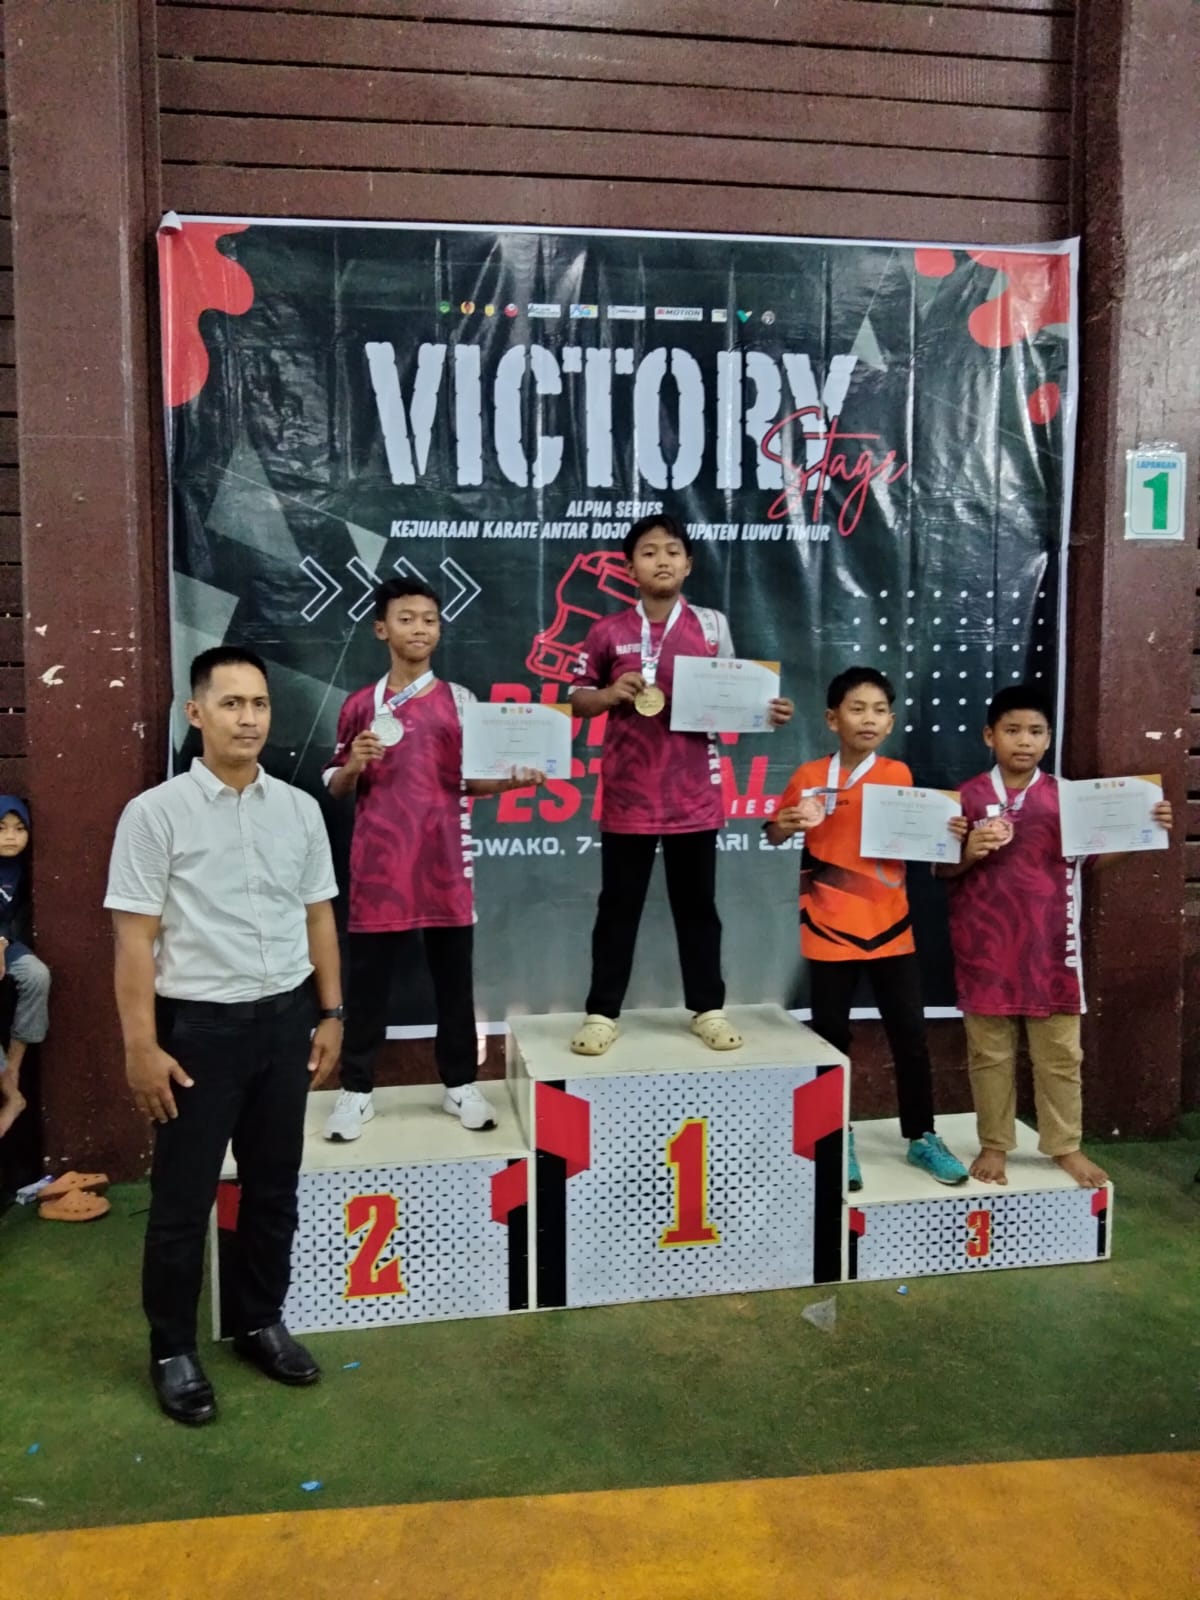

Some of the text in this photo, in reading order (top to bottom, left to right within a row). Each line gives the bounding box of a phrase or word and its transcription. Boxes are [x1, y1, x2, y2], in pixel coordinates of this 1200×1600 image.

[365, 341, 858, 490] VICTORY
[565, 500, 663, 519] ALPHA SERIES
[760, 406, 909, 536] Stage
[1142, 472, 1169, 530] 1
[390, 520, 479, 538] KEJUARAAN
[482, 521, 539, 539] KARATE
[540, 521, 588, 539] ANTAR
[741, 523, 782, 541] LUWU
[786, 524, 830, 542] TIMUR
[659, 1117, 720, 1249] 1
[343, 1192, 407, 1300] 2
[965, 1210, 993, 1258] 3
